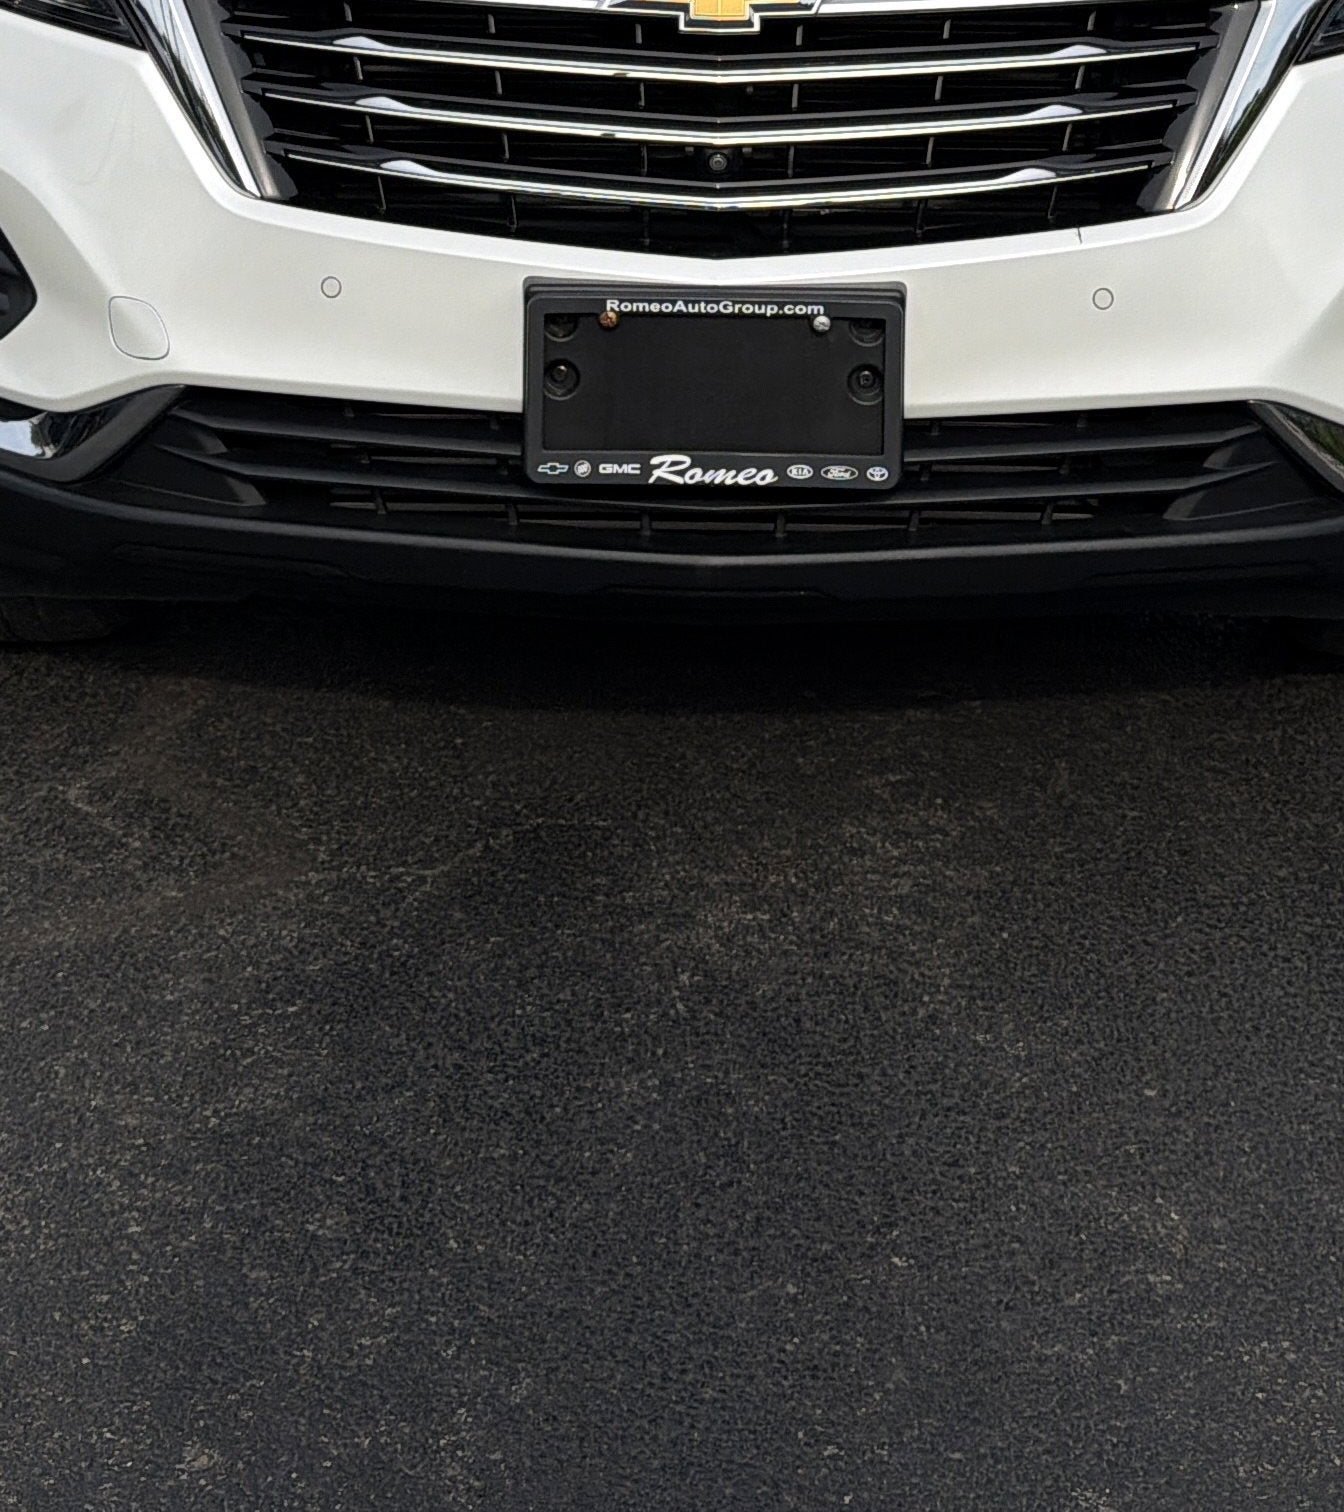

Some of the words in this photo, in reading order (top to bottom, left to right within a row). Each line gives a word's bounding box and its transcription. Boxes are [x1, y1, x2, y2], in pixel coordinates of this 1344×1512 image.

[606, 299, 824, 317] RomeoAutoGroup.com
[598, 463, 641, 474] GMC
[647, 454, 778, 486] Romeo
